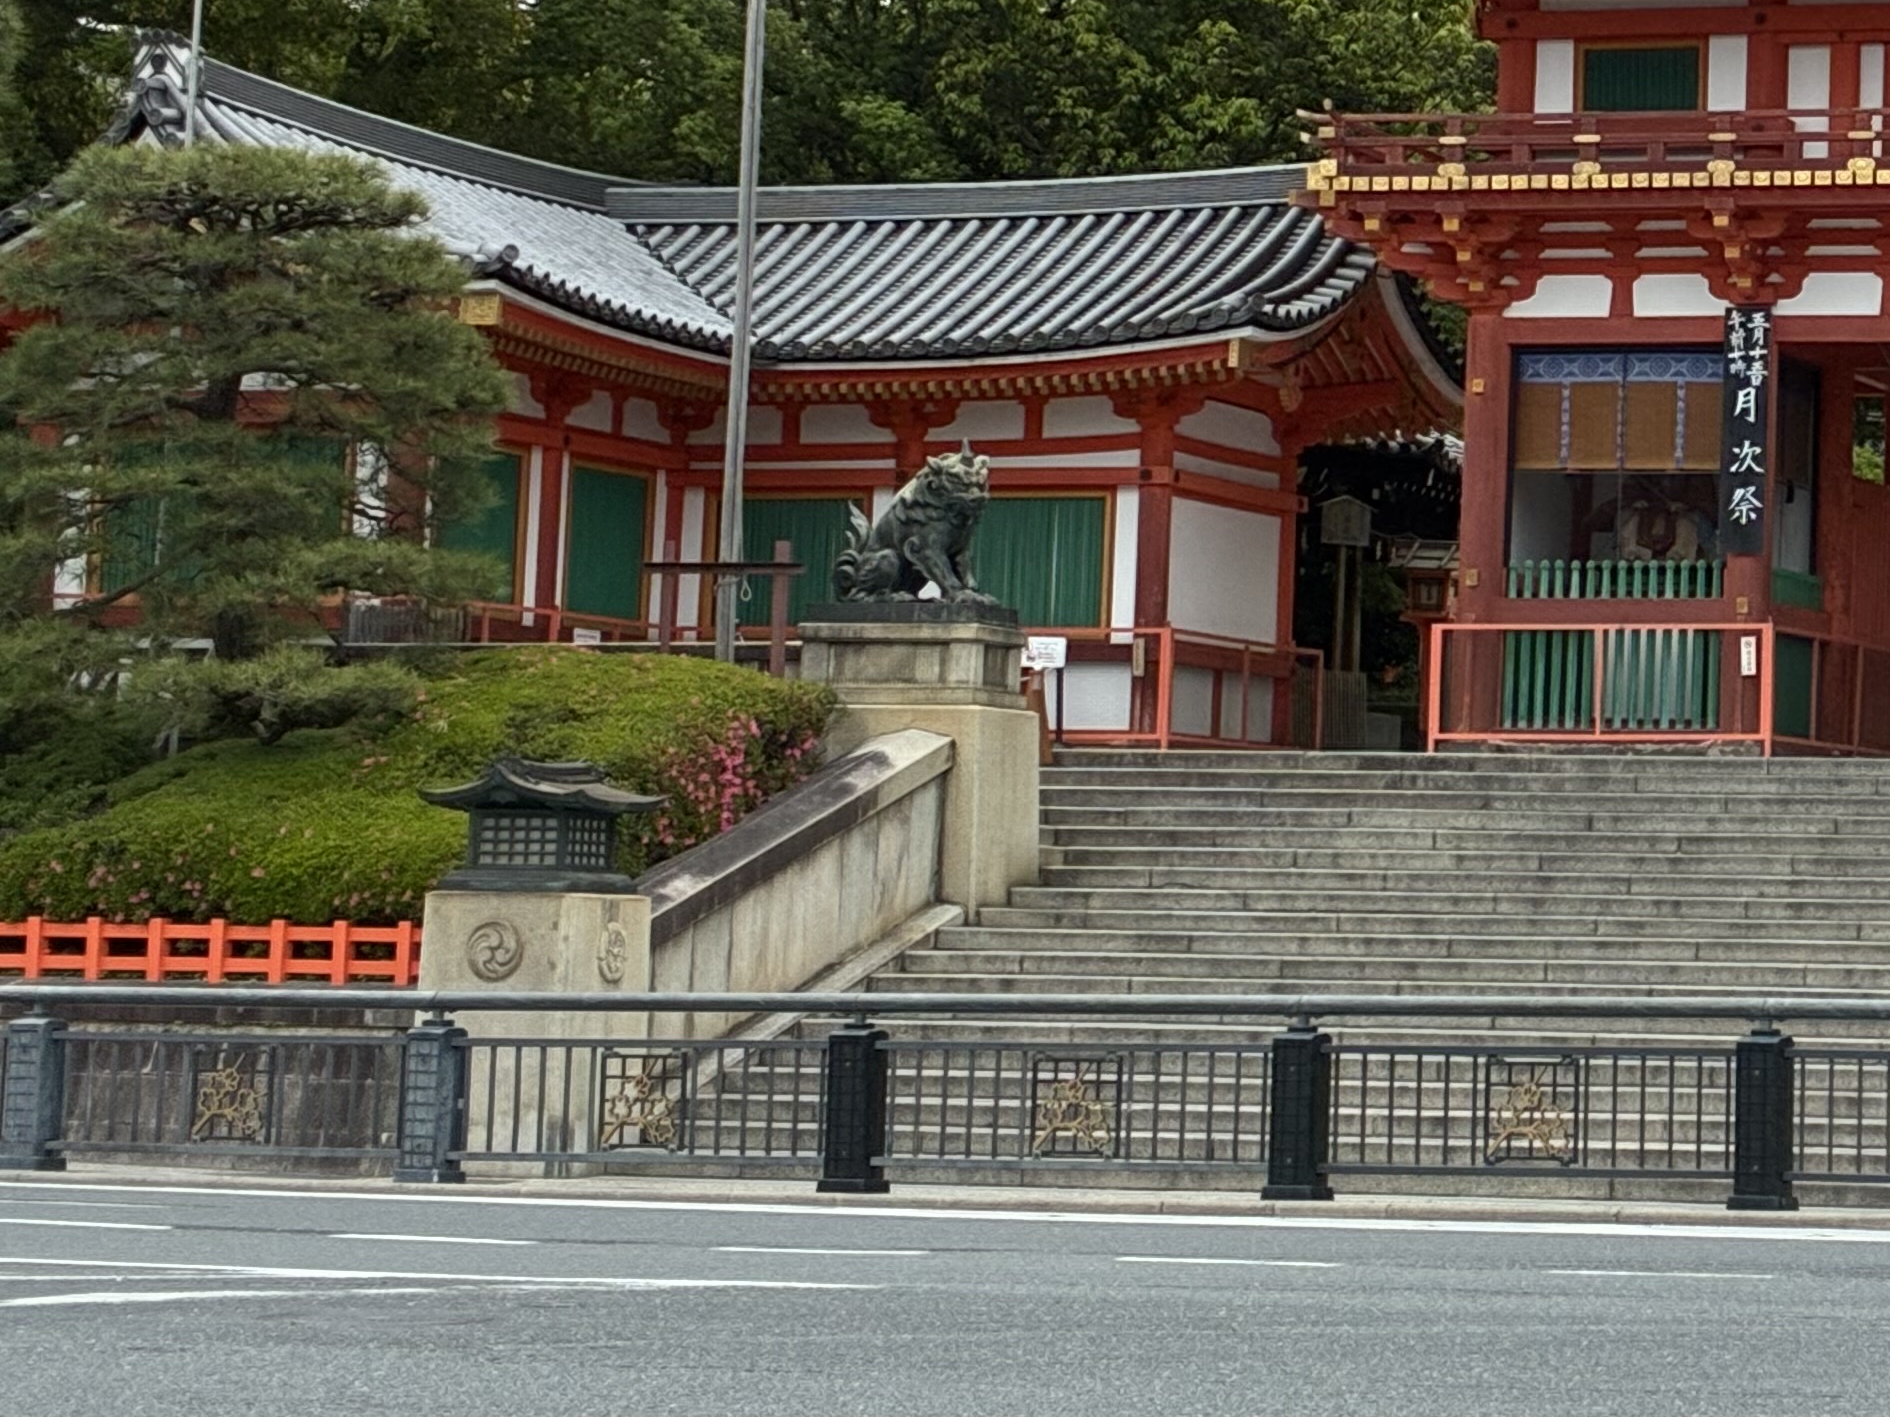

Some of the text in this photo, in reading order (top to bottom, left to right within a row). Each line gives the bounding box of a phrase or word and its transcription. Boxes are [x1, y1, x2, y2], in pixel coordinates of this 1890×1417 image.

[1727, 309, 1746, 379] 午前十時
[1745, 311, 1771, 387] 五月十五日
[1728, 386, 1765, 525] 月次祭
